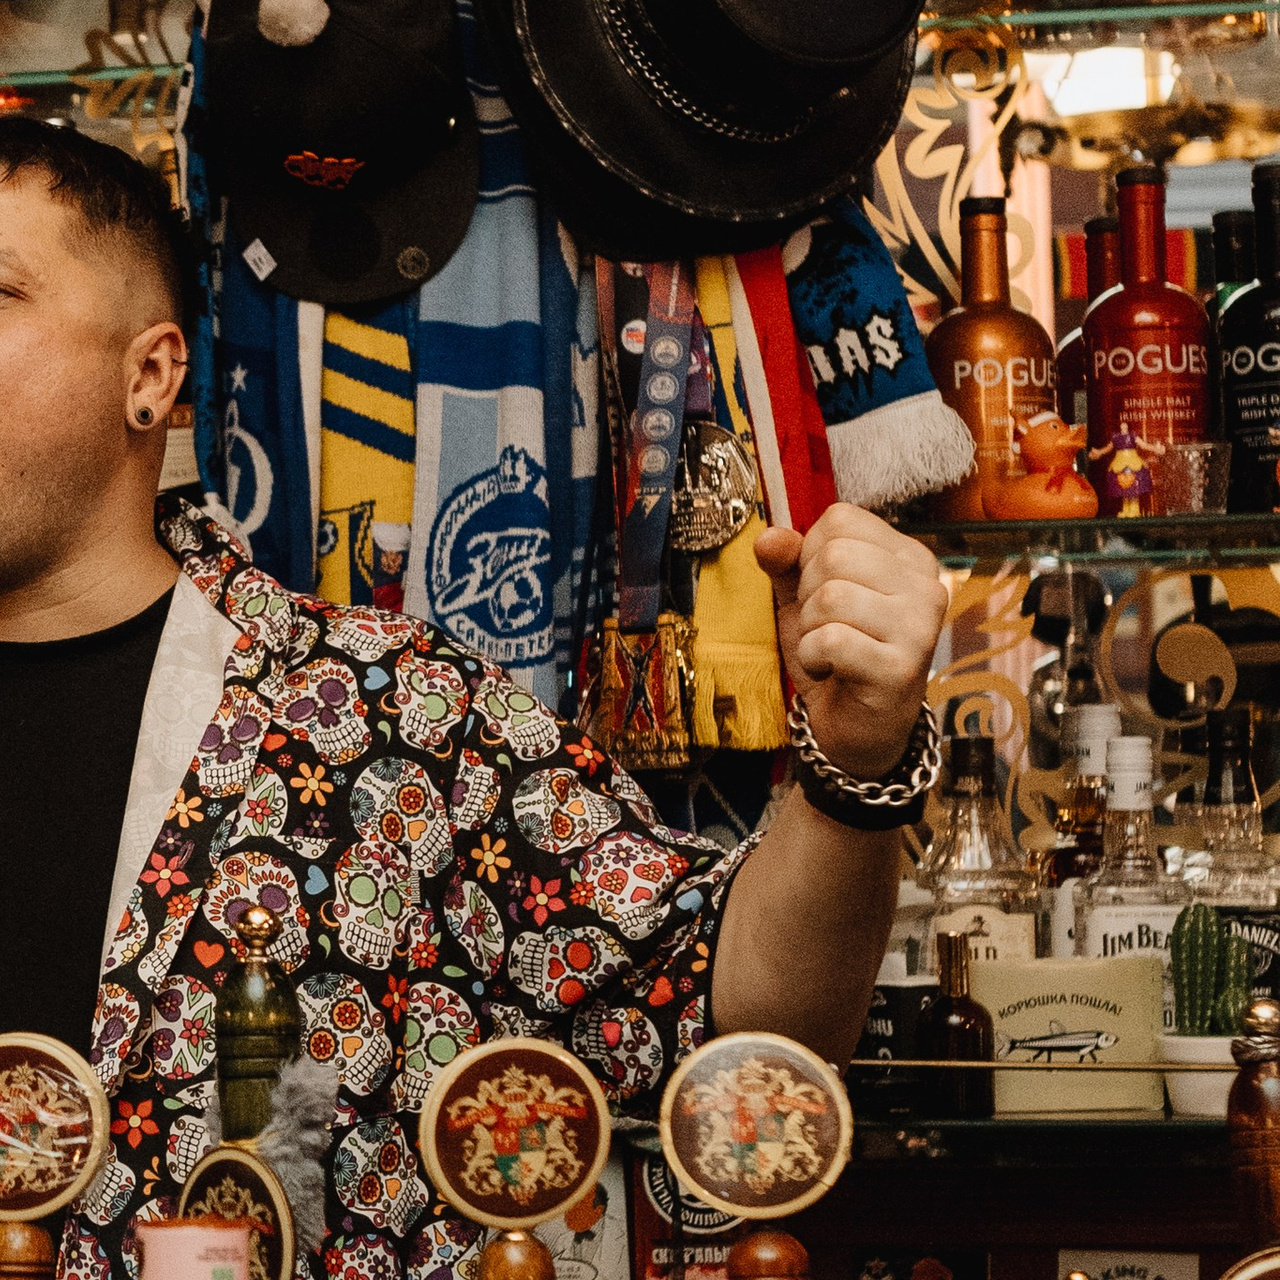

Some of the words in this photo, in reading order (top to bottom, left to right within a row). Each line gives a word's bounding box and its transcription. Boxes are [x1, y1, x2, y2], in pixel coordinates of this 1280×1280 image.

[953, 356, 1057, 390] POGUE
[1093, 342, 1208, 380] POGUES
[1123, 396, 1162, 408] SINGLE
[1166, 395, 1192, 407] MALT
[1137, 923, 1174, 951] BEA
[997, 994, 1068, 1019] КОРЮШКА
[1070, 993, 1123, 1018] ПОШЛА!
